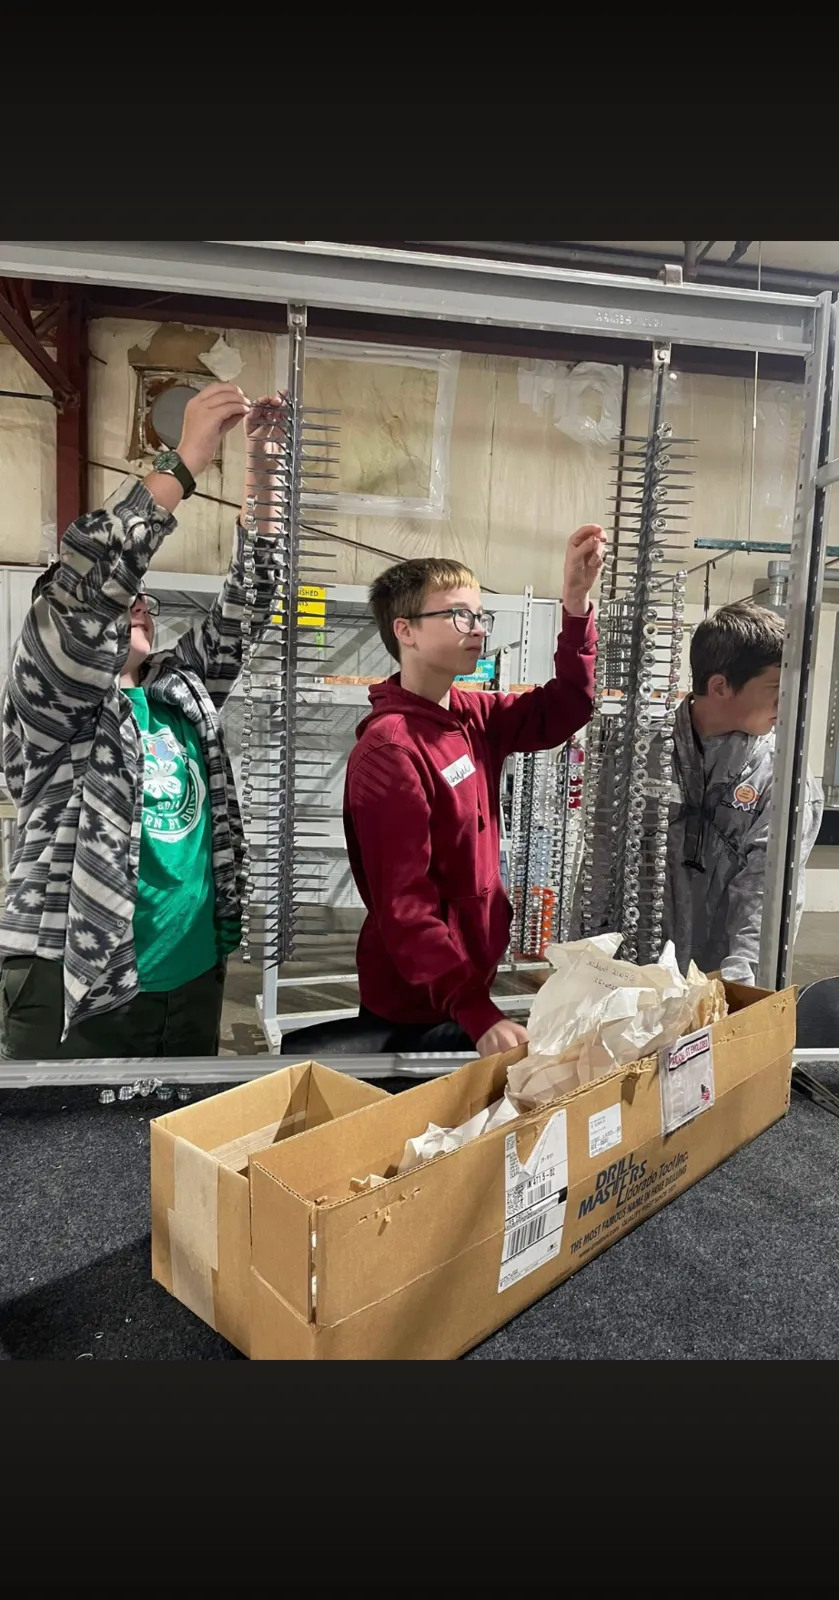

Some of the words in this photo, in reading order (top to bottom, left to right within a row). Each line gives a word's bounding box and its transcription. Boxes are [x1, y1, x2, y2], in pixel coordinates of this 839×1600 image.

[168, 818, 181, 830] BY
[595, 1153, 635, 1192] DRILL
[659, 1155, 676, 1180] Tool
[570, 1238, 582, 1255] THE
[582, 1224, 601, 1246] MOST
[601, 1207, 626, 1232] FAMOUS
[627, 1195, 644, 1213] NAME
